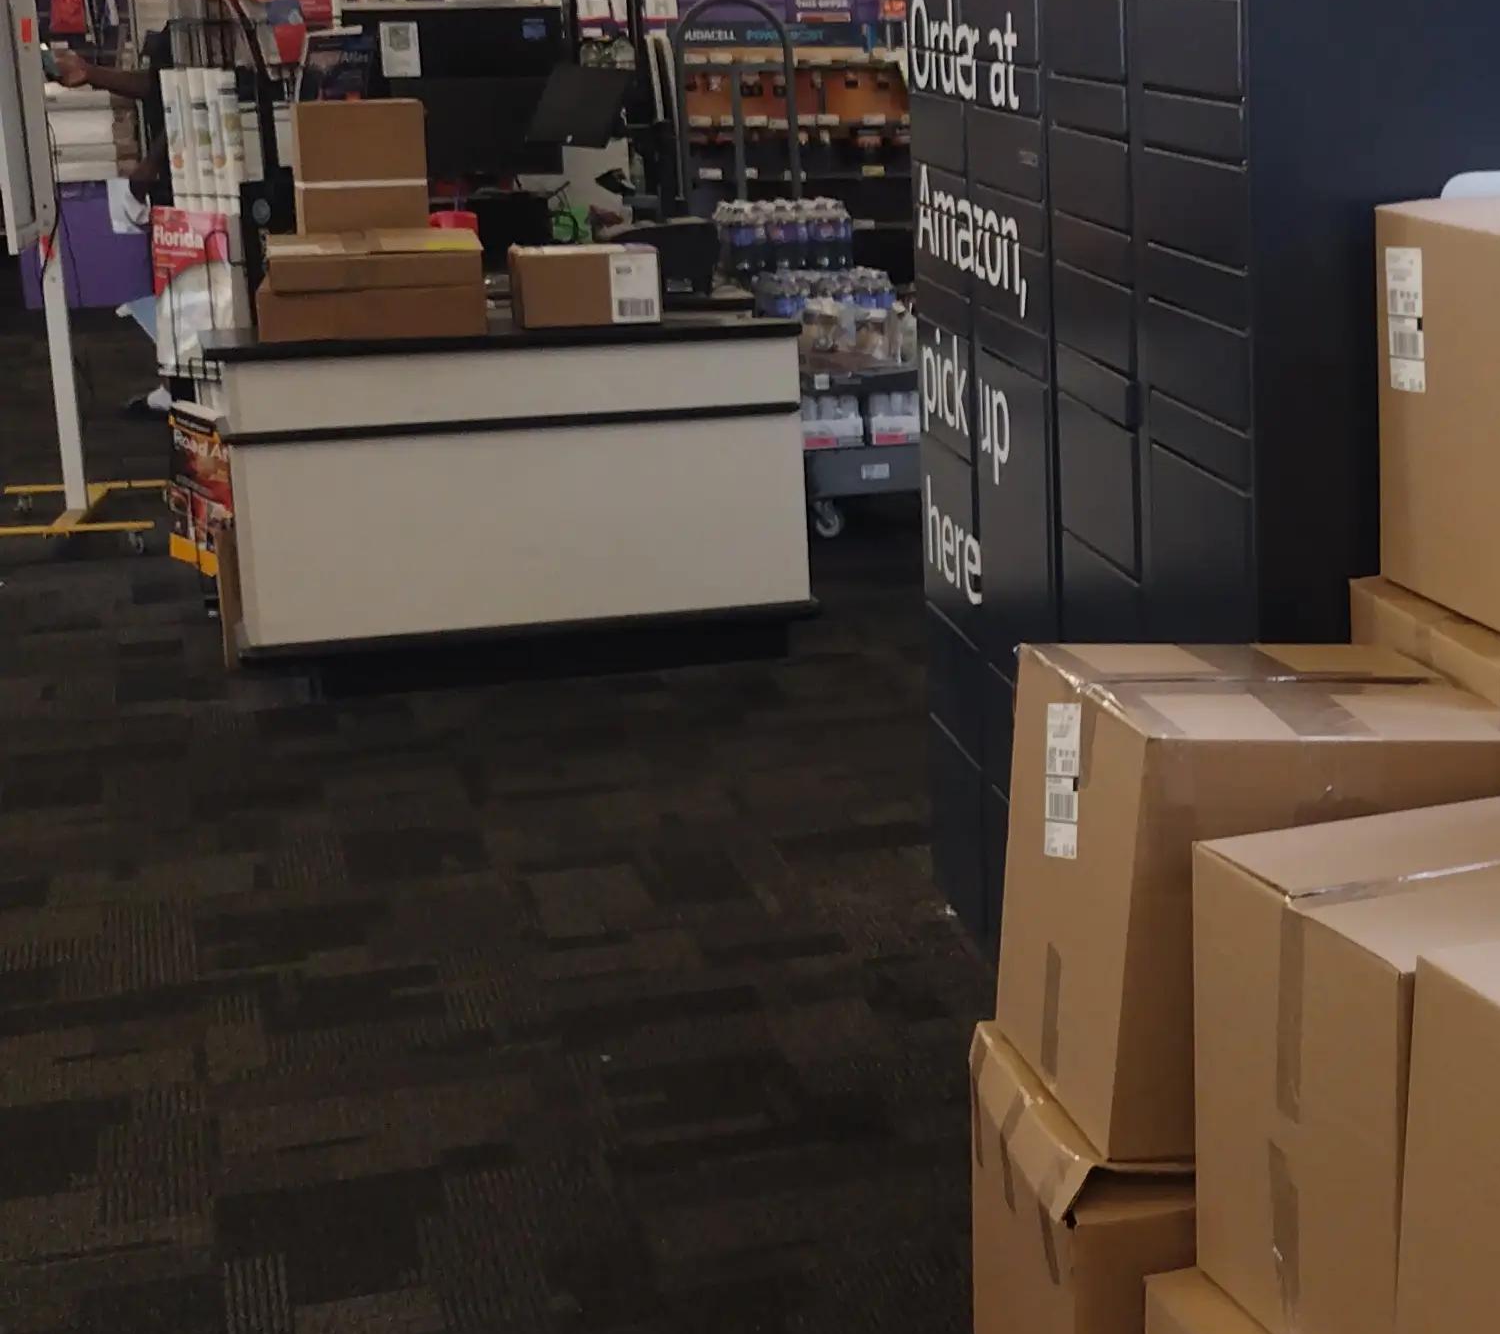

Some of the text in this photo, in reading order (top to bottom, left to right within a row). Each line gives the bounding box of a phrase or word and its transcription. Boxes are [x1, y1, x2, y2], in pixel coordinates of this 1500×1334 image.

[989, 11, 1020, 111] at
[153, 224, 205, 250] Florida
[917, 164, 1028, 320] Amazon,
[921, 327, 1011, 486] pick up
[925, 474, 983, 606] here
